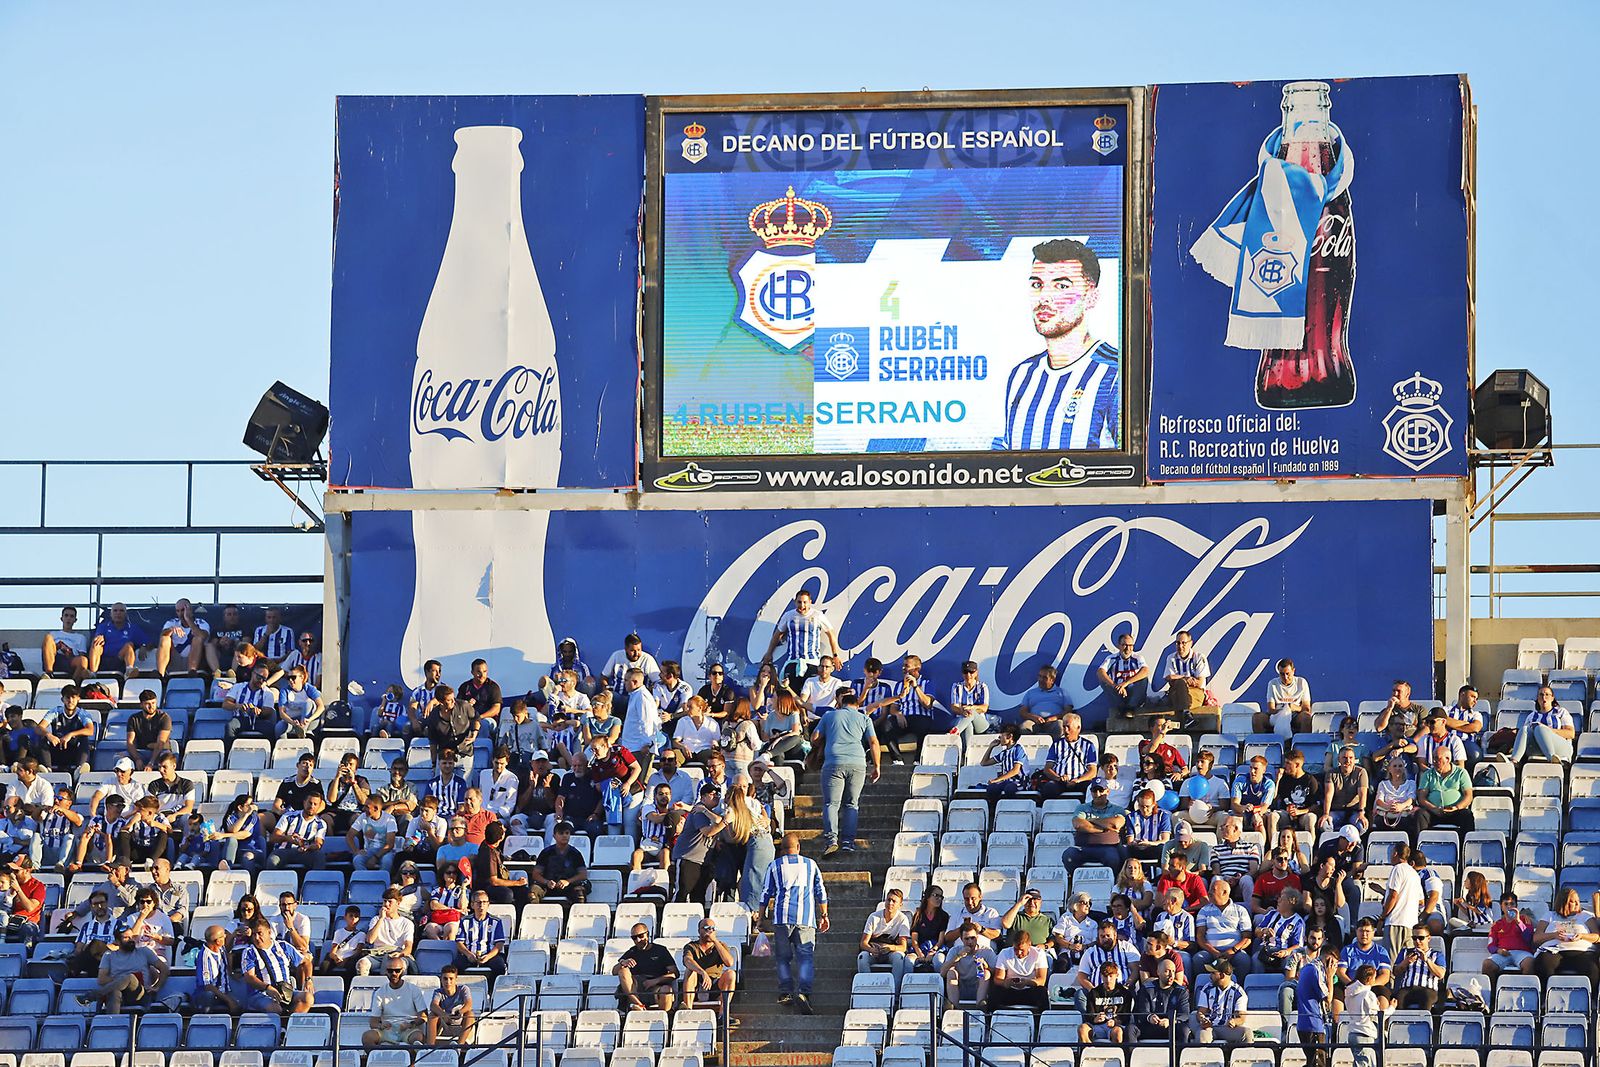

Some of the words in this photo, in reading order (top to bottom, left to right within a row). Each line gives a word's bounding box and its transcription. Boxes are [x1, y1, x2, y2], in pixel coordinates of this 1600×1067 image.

[723, 134, 815, 153] DECANO
[821, 133, 863, 151] DEL
[869, 128, 956, 150] FÚTBOL
[962, 126, 1064, 149] ESPAÑOL
[880, 280, 900, 320] 4
[879, 321, 958, 351] RUBÉN
[879, 355, 988, 382] SERRANO
[413, 365, 558, 444] Coca-Cola
[673, 403, 688, 426] 4
[701, 402, 804, 425] RUBEN
[816, 400, 966, 424] SERRANO
[1159, 414, 1222, 434] Refresco
[1227, 414, 1271, 433] Oficial
[1275, 412, 1301, 431] del:
[1159, 440, 1184, 458] R.C.
[1189, 438, 1265, 458] Recreativo
[1270, 437, 1288, 456] de
[1293, 435, 1339, 455] Huelva
[766, 463, 1023, 487] www.alosonido.net
[1160, 464, 1189, 475] Decano
[1191, 463, 1203, 474] del
[1205, 462, 1231, 474] fútbol
[1232, 462, 1265, 476] español
[1273, 460, 1307, 473] Fundado
[1309, 462, 1319, 472] en
[1321, 460, 1339, 471] 1889
[680, 515, 1314, 712] Coca-Cola
